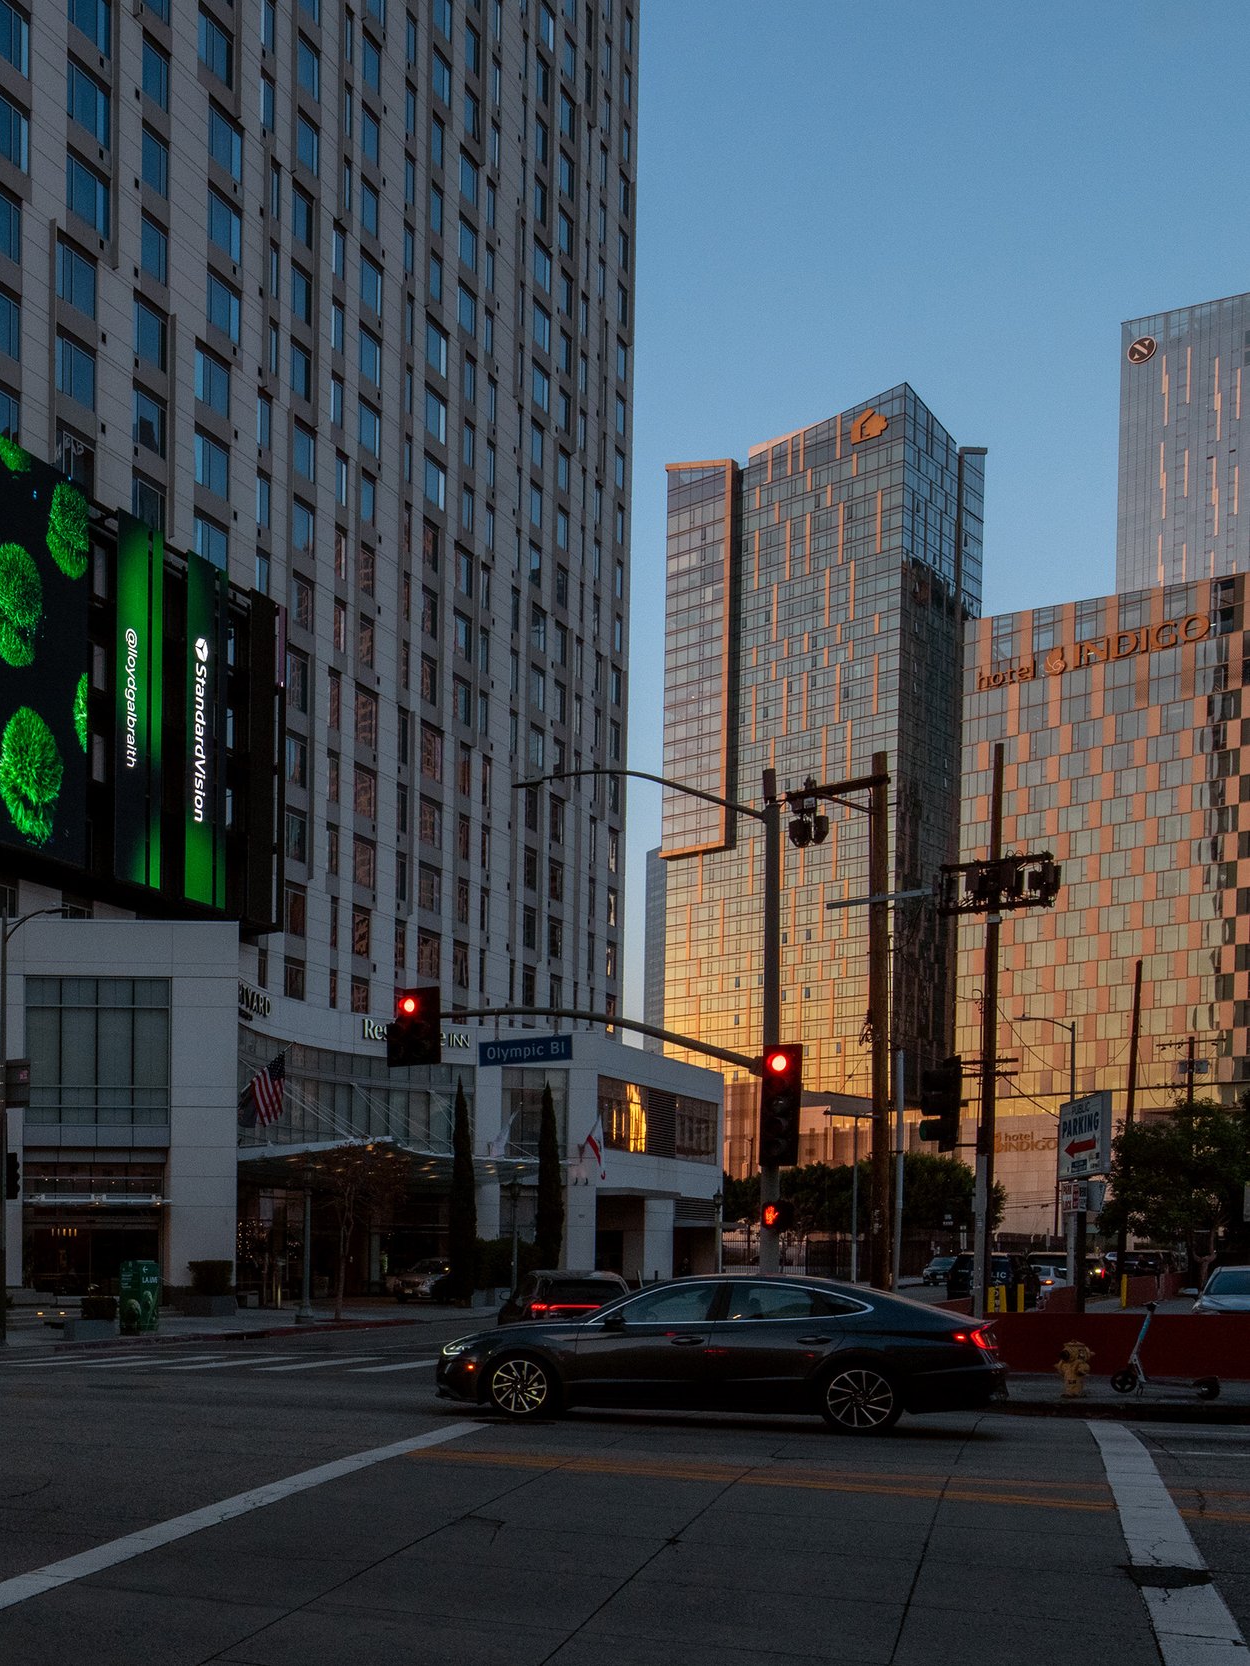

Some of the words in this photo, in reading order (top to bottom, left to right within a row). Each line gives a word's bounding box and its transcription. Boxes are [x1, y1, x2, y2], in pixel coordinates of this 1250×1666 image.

[976, 654, 1036, 690] hotel
[1073, 615, 1211, 669] INDIGO
[124, 627, 138, 768] @lloydgalbraith
[194, 662, 208, 823] StandardVision
[448, 1033, 470, 1048] INN
[486, 1043, 545, 1062] Olympic
[1004, 1131, 1034, 1142] hotel
[1062, 1111, 1099, 1139] PARKING
[1004, 1140, 1058, 1152] INDIGO
